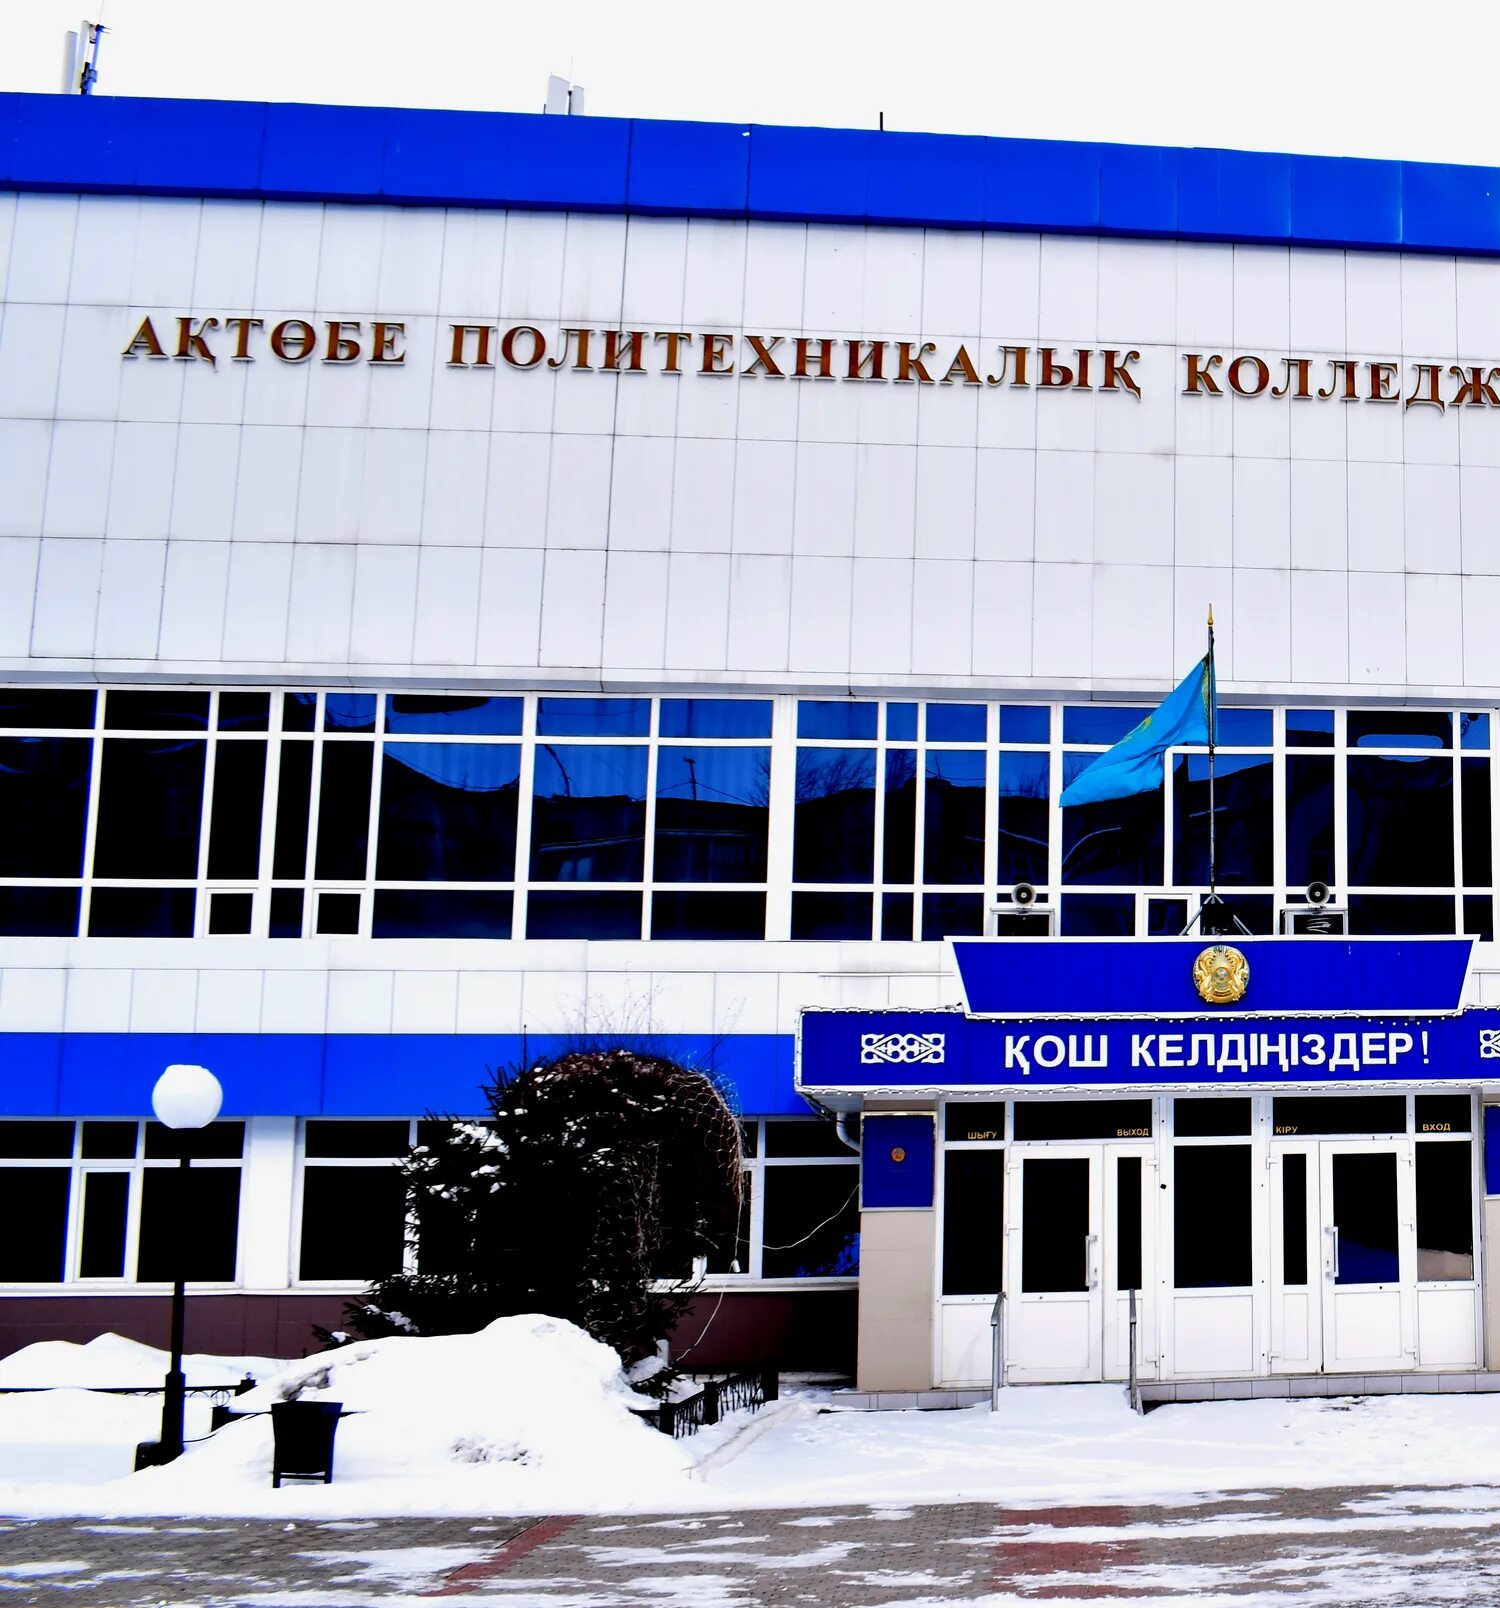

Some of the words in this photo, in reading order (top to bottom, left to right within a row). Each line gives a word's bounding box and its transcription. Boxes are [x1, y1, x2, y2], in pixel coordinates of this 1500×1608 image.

[120, 315, 406, 373] АҚТӨБЕ
[446, 323, 1142, 401] ПОЛИТЕХНИКАЛЫҚ
[1004, 1034, 1109, 1075] ҚОШ
[1275, 1126, 1298, 1134] КІРУ
[1422, 1123, 1451, 1131] ВХОД
[967, 1130, 998, 1140] ШЫҒУ
[1116, 1128, 1150, 1137] ВЫХОД
